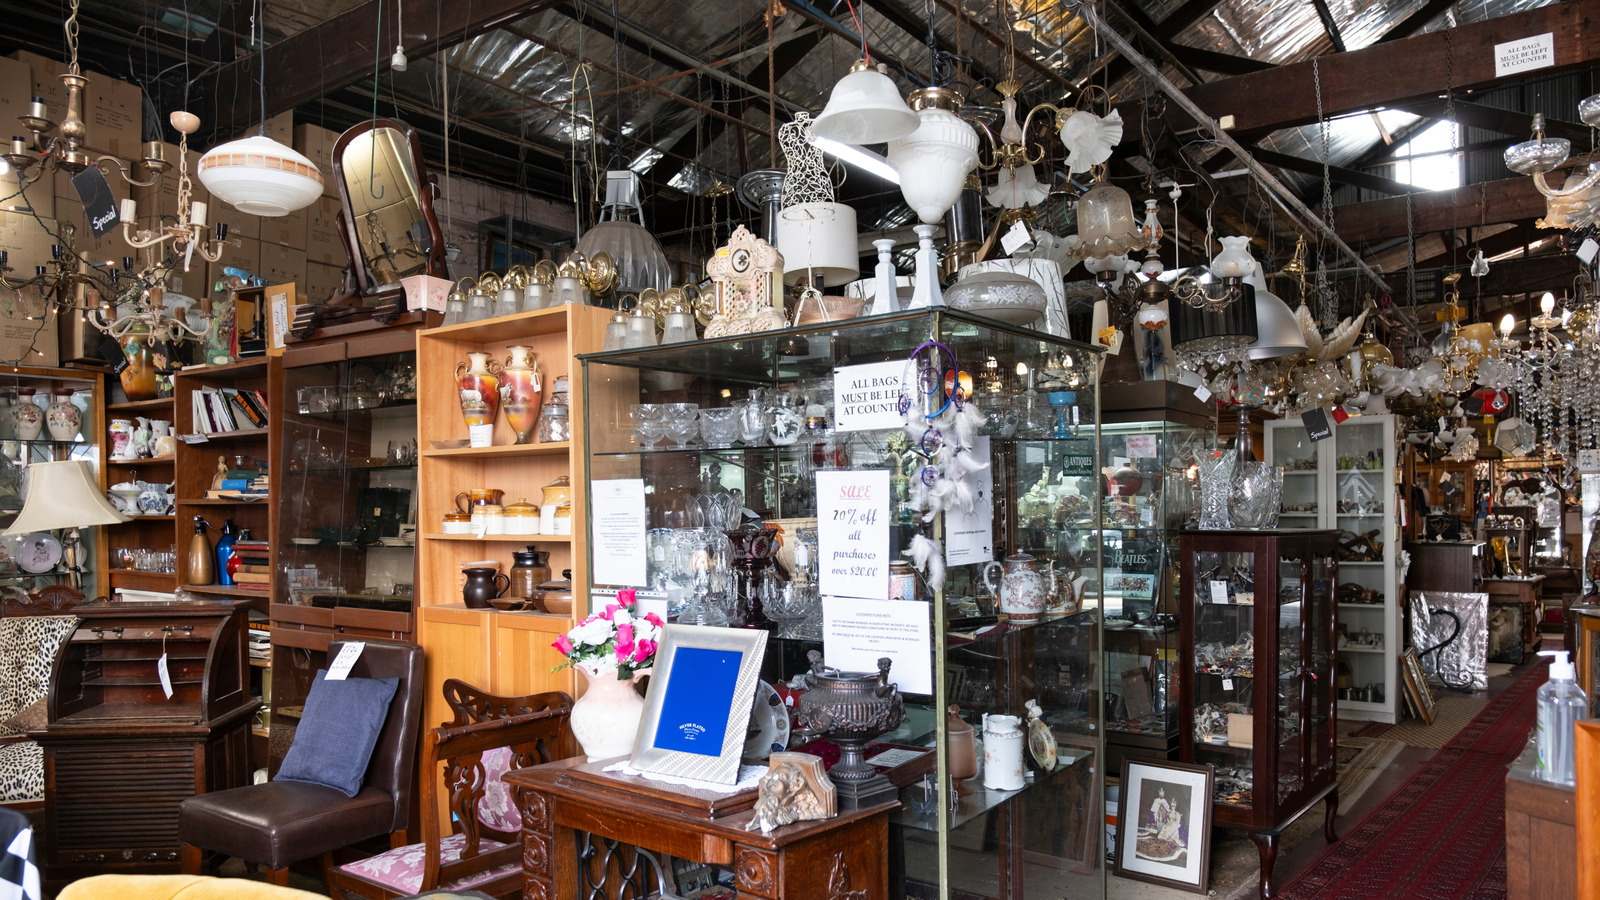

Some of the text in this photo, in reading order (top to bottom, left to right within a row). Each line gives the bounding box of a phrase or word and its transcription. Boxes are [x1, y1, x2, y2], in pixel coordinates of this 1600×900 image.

[1522, 42, 1540, 50] BAGS
[1500, 54, 1519, 62] MUST
[1531, 47, 1548, 55] LEFT
[1512, 54, 1547, 66] COUNTER
[92, 205, 116, 231] Special
[851, 376, 898, 389] ALL BAGS
[841, 392, 868, 404] MUST
[870, 391, 882, 400] BE
[843, 406, 856, 415] AT
[1311, 427, 1328, 439] Special
[1070, 456, 1092, 467] ANTIQUES
[840, 485, 871, 500] SALE
[860, 508, 877, 525] off
[848, 530, 861, 540] all
[833, 548, 876, 560] purchases
[1115, 550, 1147, 565] BEATLES
[850, 566, 878, 577] $20.00
